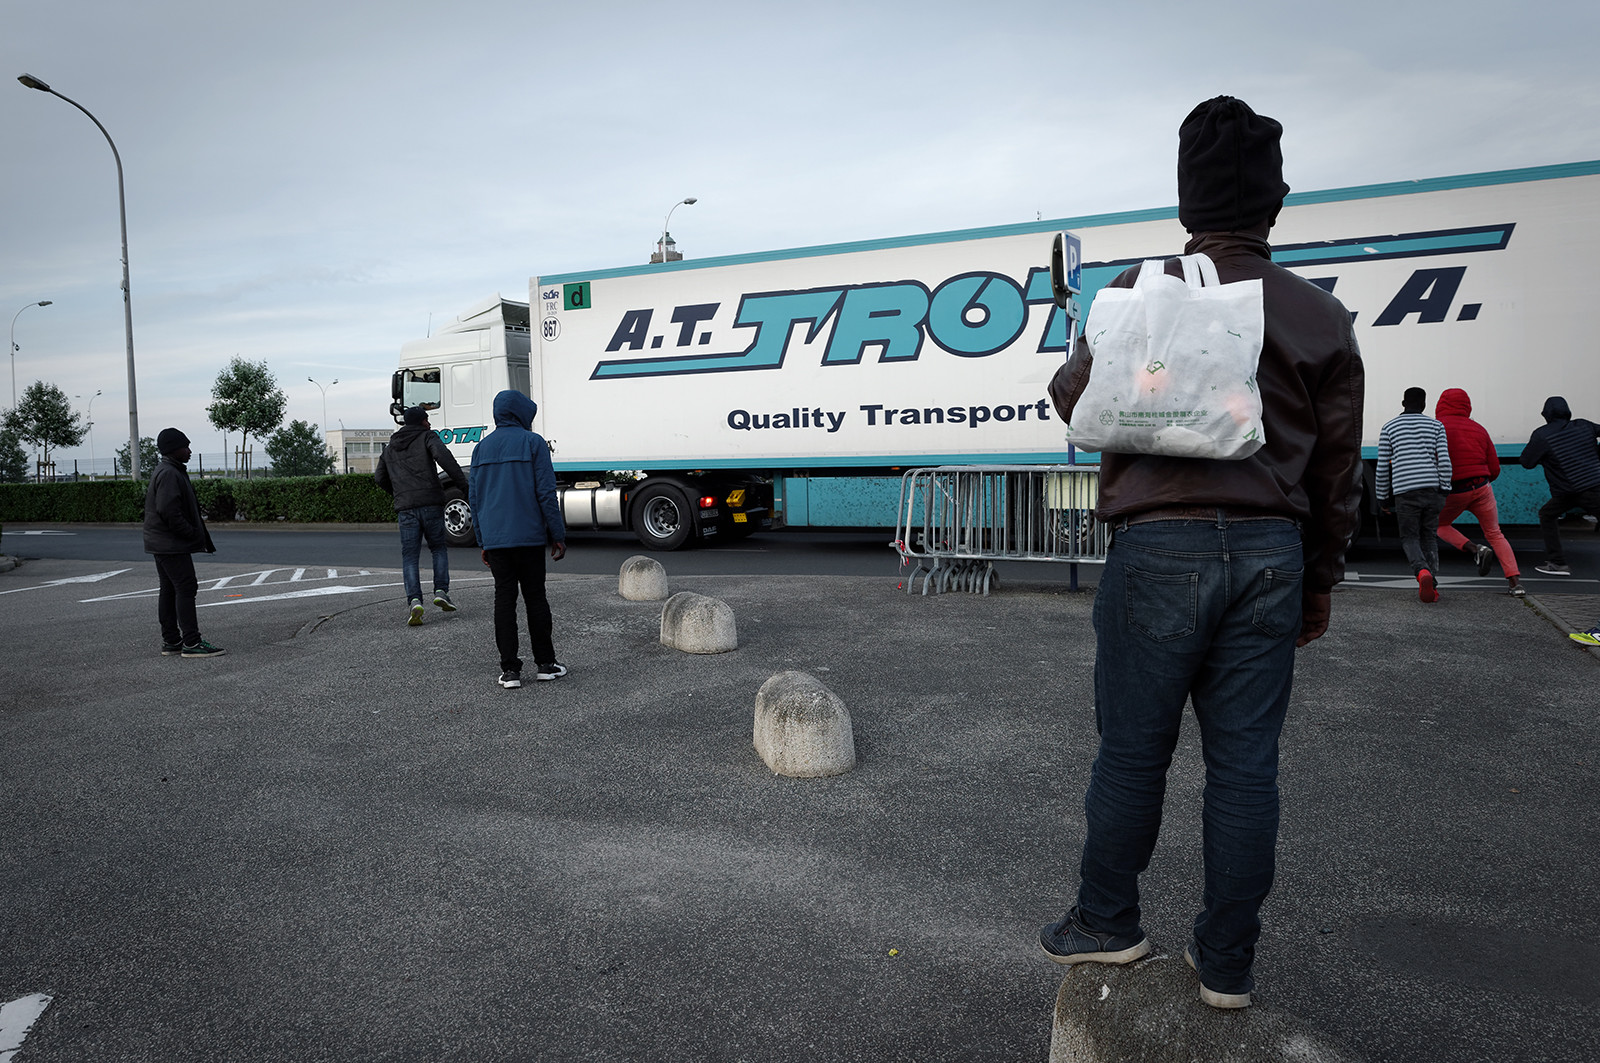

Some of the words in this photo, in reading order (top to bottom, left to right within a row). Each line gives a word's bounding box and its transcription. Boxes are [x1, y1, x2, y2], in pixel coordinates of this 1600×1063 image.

[1069, 245, 1077, 279] P
[546, 301, 558, 311] FRC
[571, 285, 583, 306] d
[543, 320, 557, 338] 867
[605, 302, 721, 352] A.T.
[727, 407, 846, 433] Quality
[860, 398, 1051, 428] Transport
